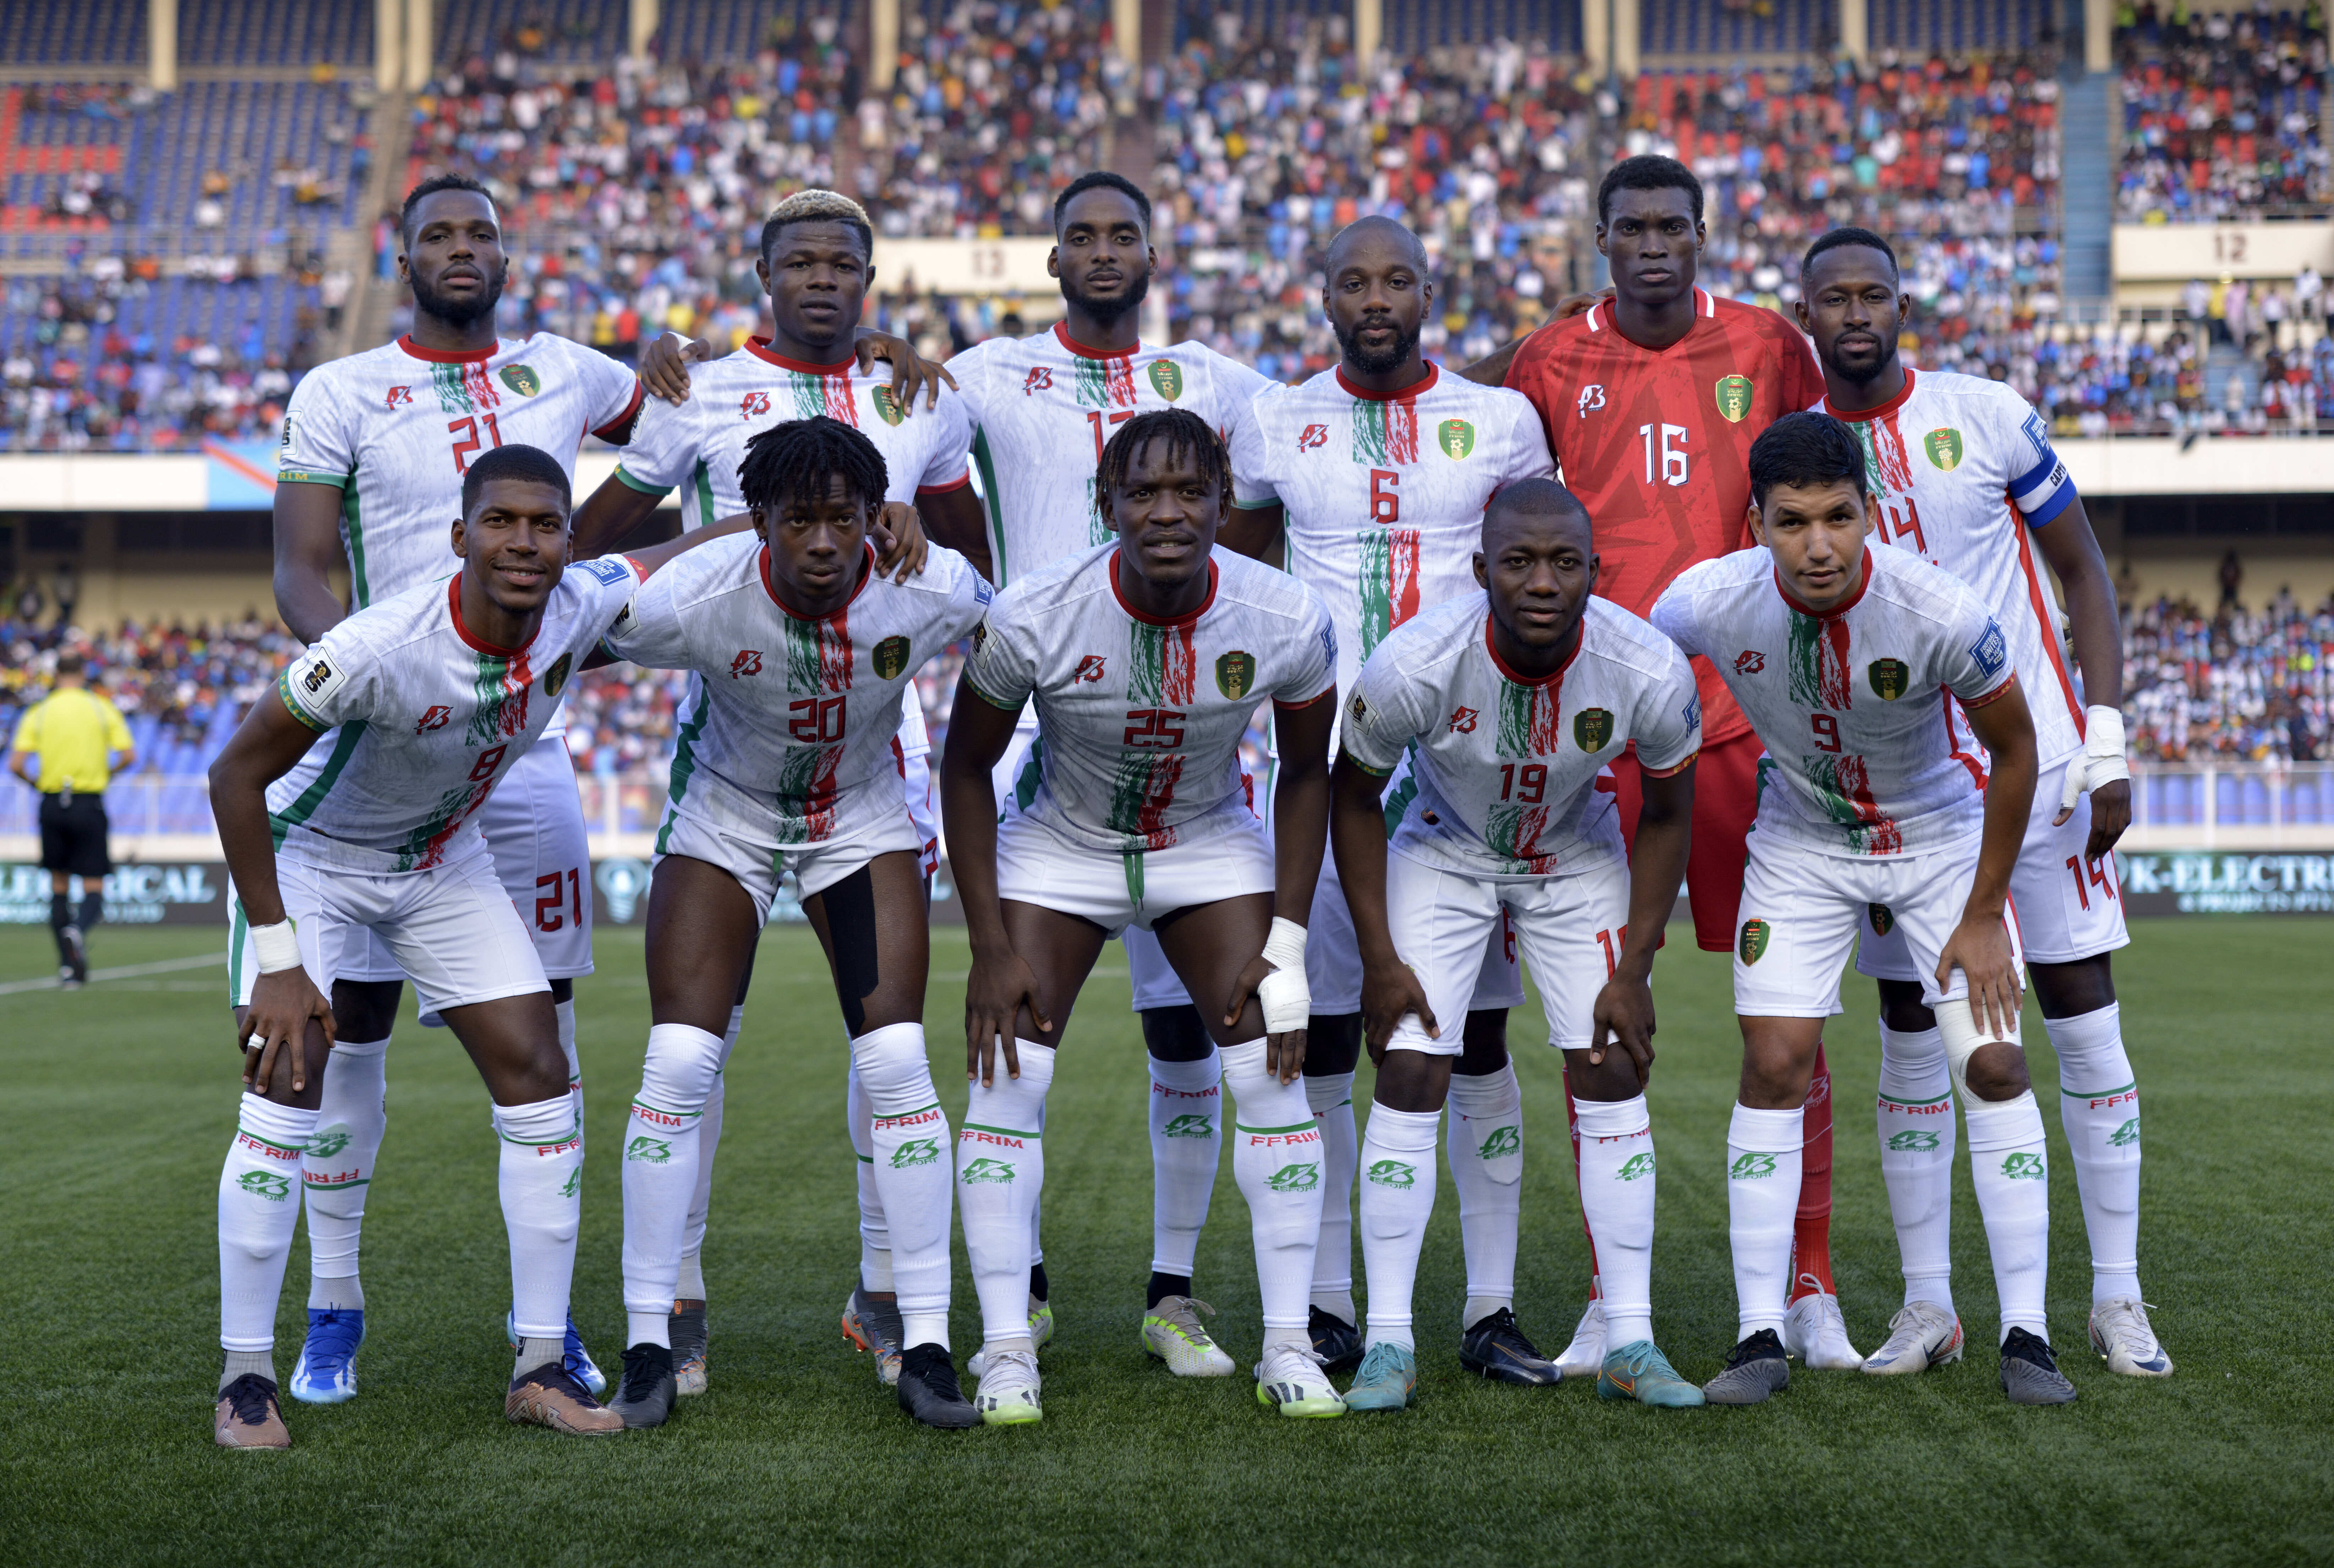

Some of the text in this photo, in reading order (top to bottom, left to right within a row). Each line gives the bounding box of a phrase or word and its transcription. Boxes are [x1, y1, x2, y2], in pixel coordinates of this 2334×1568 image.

[448, 413, 503, 477] 21
[1640, 423, 1689, 487] 16
[1371, 468, 1398, 524] 6
[1877, 497, 1928, 554] 14
[1980, 630, 1995, 653] FOOTBALL
[1983, 634, 1999, 659] UNITES
[281, 675, 315, 728] FFRIM
[300, 680, 313, 697] QUALIFIERS
[789, 696, 846, 743] 20
[1124, 708, 1186, 748] 25
[1811, 713, 1842, 753] 9
[1501, 764, 1547, 803] 19
[536, 867, 582, 932] 21
[2066, 855, 2115, 911] 14
[1153, 1082, 1218, 1098] FFRIM
[1878, 1100, 1950, 1114] FFRIM
[875, 1110, 939, 1130] FFRIM
[239, 1134, 300, 1160] FFRIM
[1250, 1131, 1321, 1147] FFRIM
[902, 1157, 937, 1168] SPORT
[248, 1187, 287, 1202] SPORT
[1374, 1178, 1412, 1191] SPORT
[508, 1398, 580, 1433] AIR
